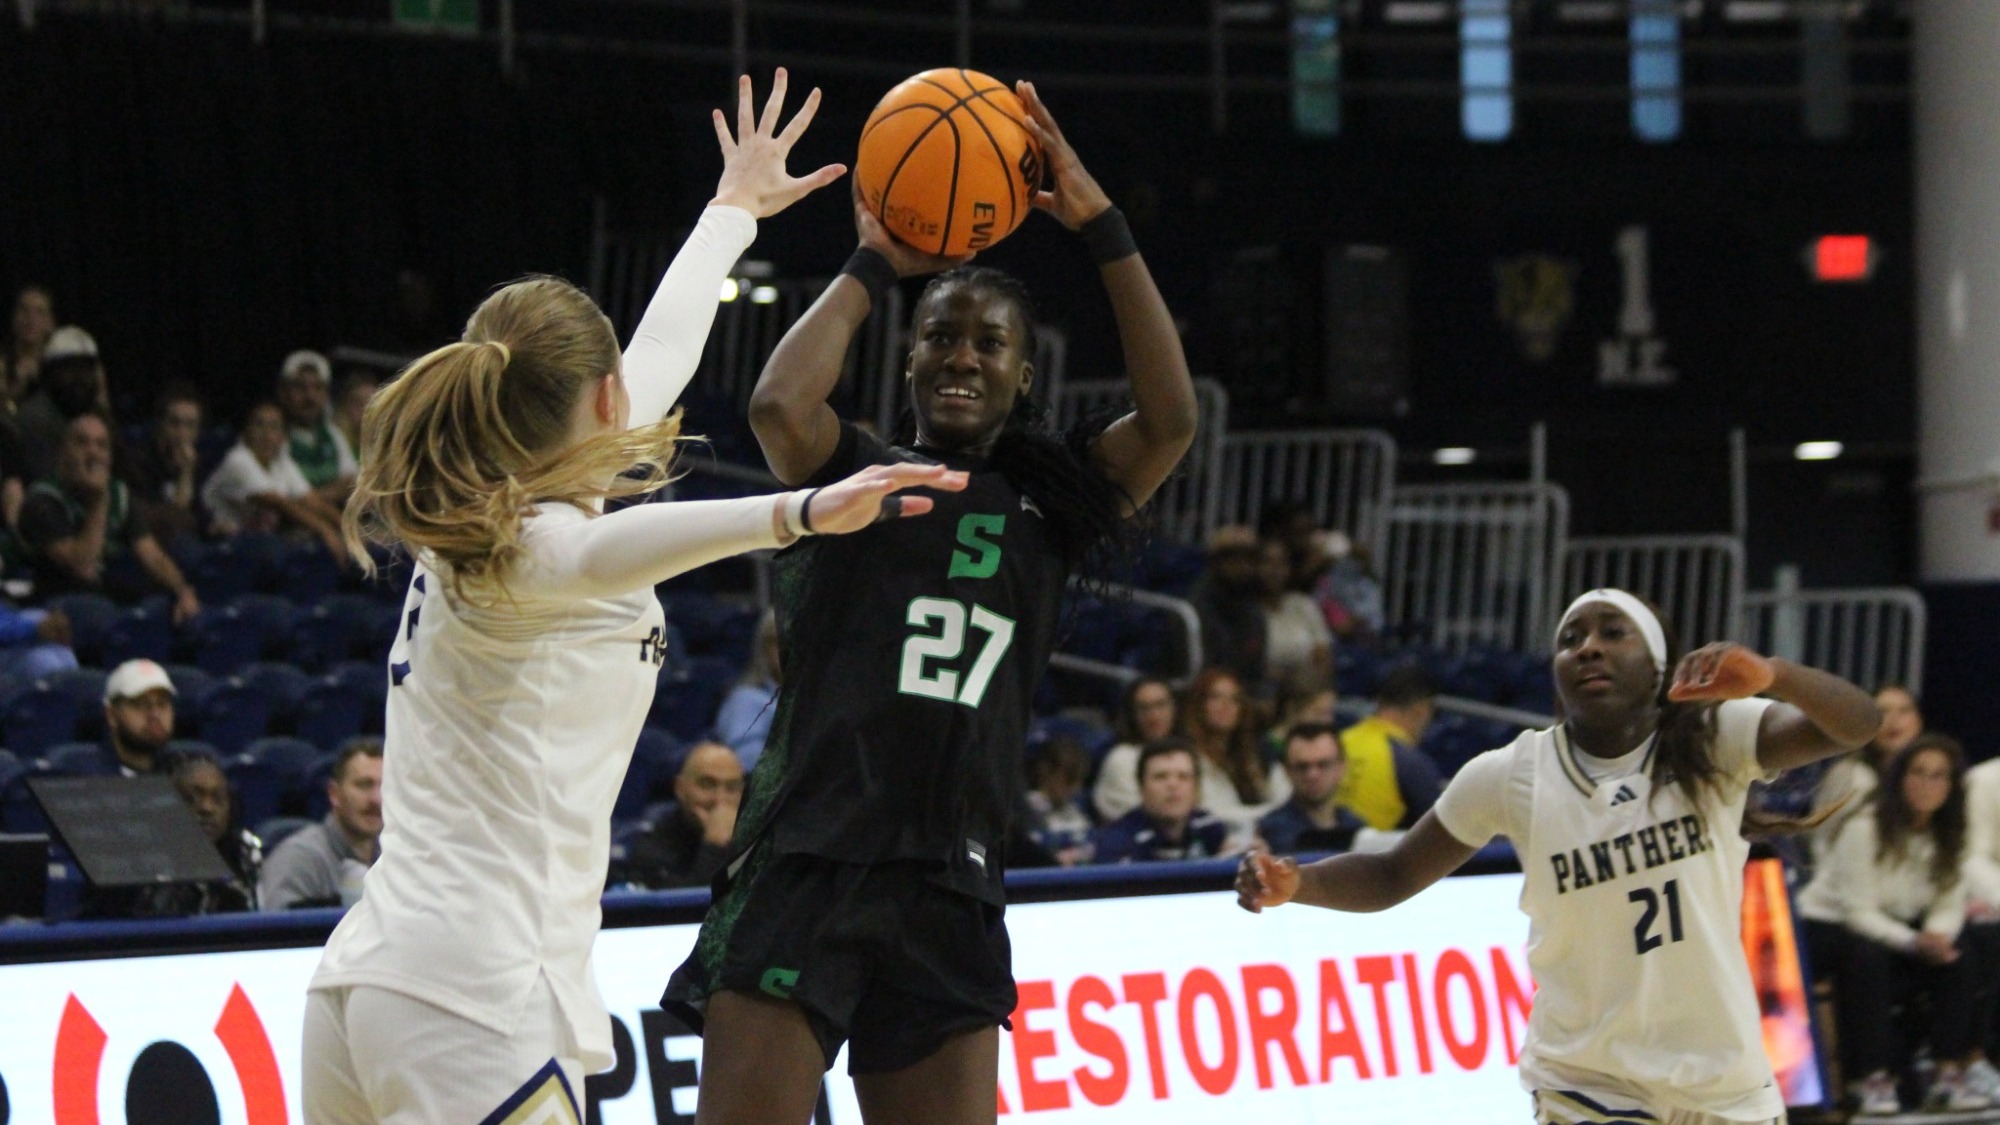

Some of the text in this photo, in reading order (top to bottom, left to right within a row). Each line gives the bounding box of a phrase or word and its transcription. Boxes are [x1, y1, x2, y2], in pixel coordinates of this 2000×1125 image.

[948, 513, 1006, 579] S
[898, 596, 1016, 709] 27
[1551, 814, 1714, 894] PANTHER
[1628, 878, 1684, 956] 21
[997, 945, 1539, 1115] ESTORATION
